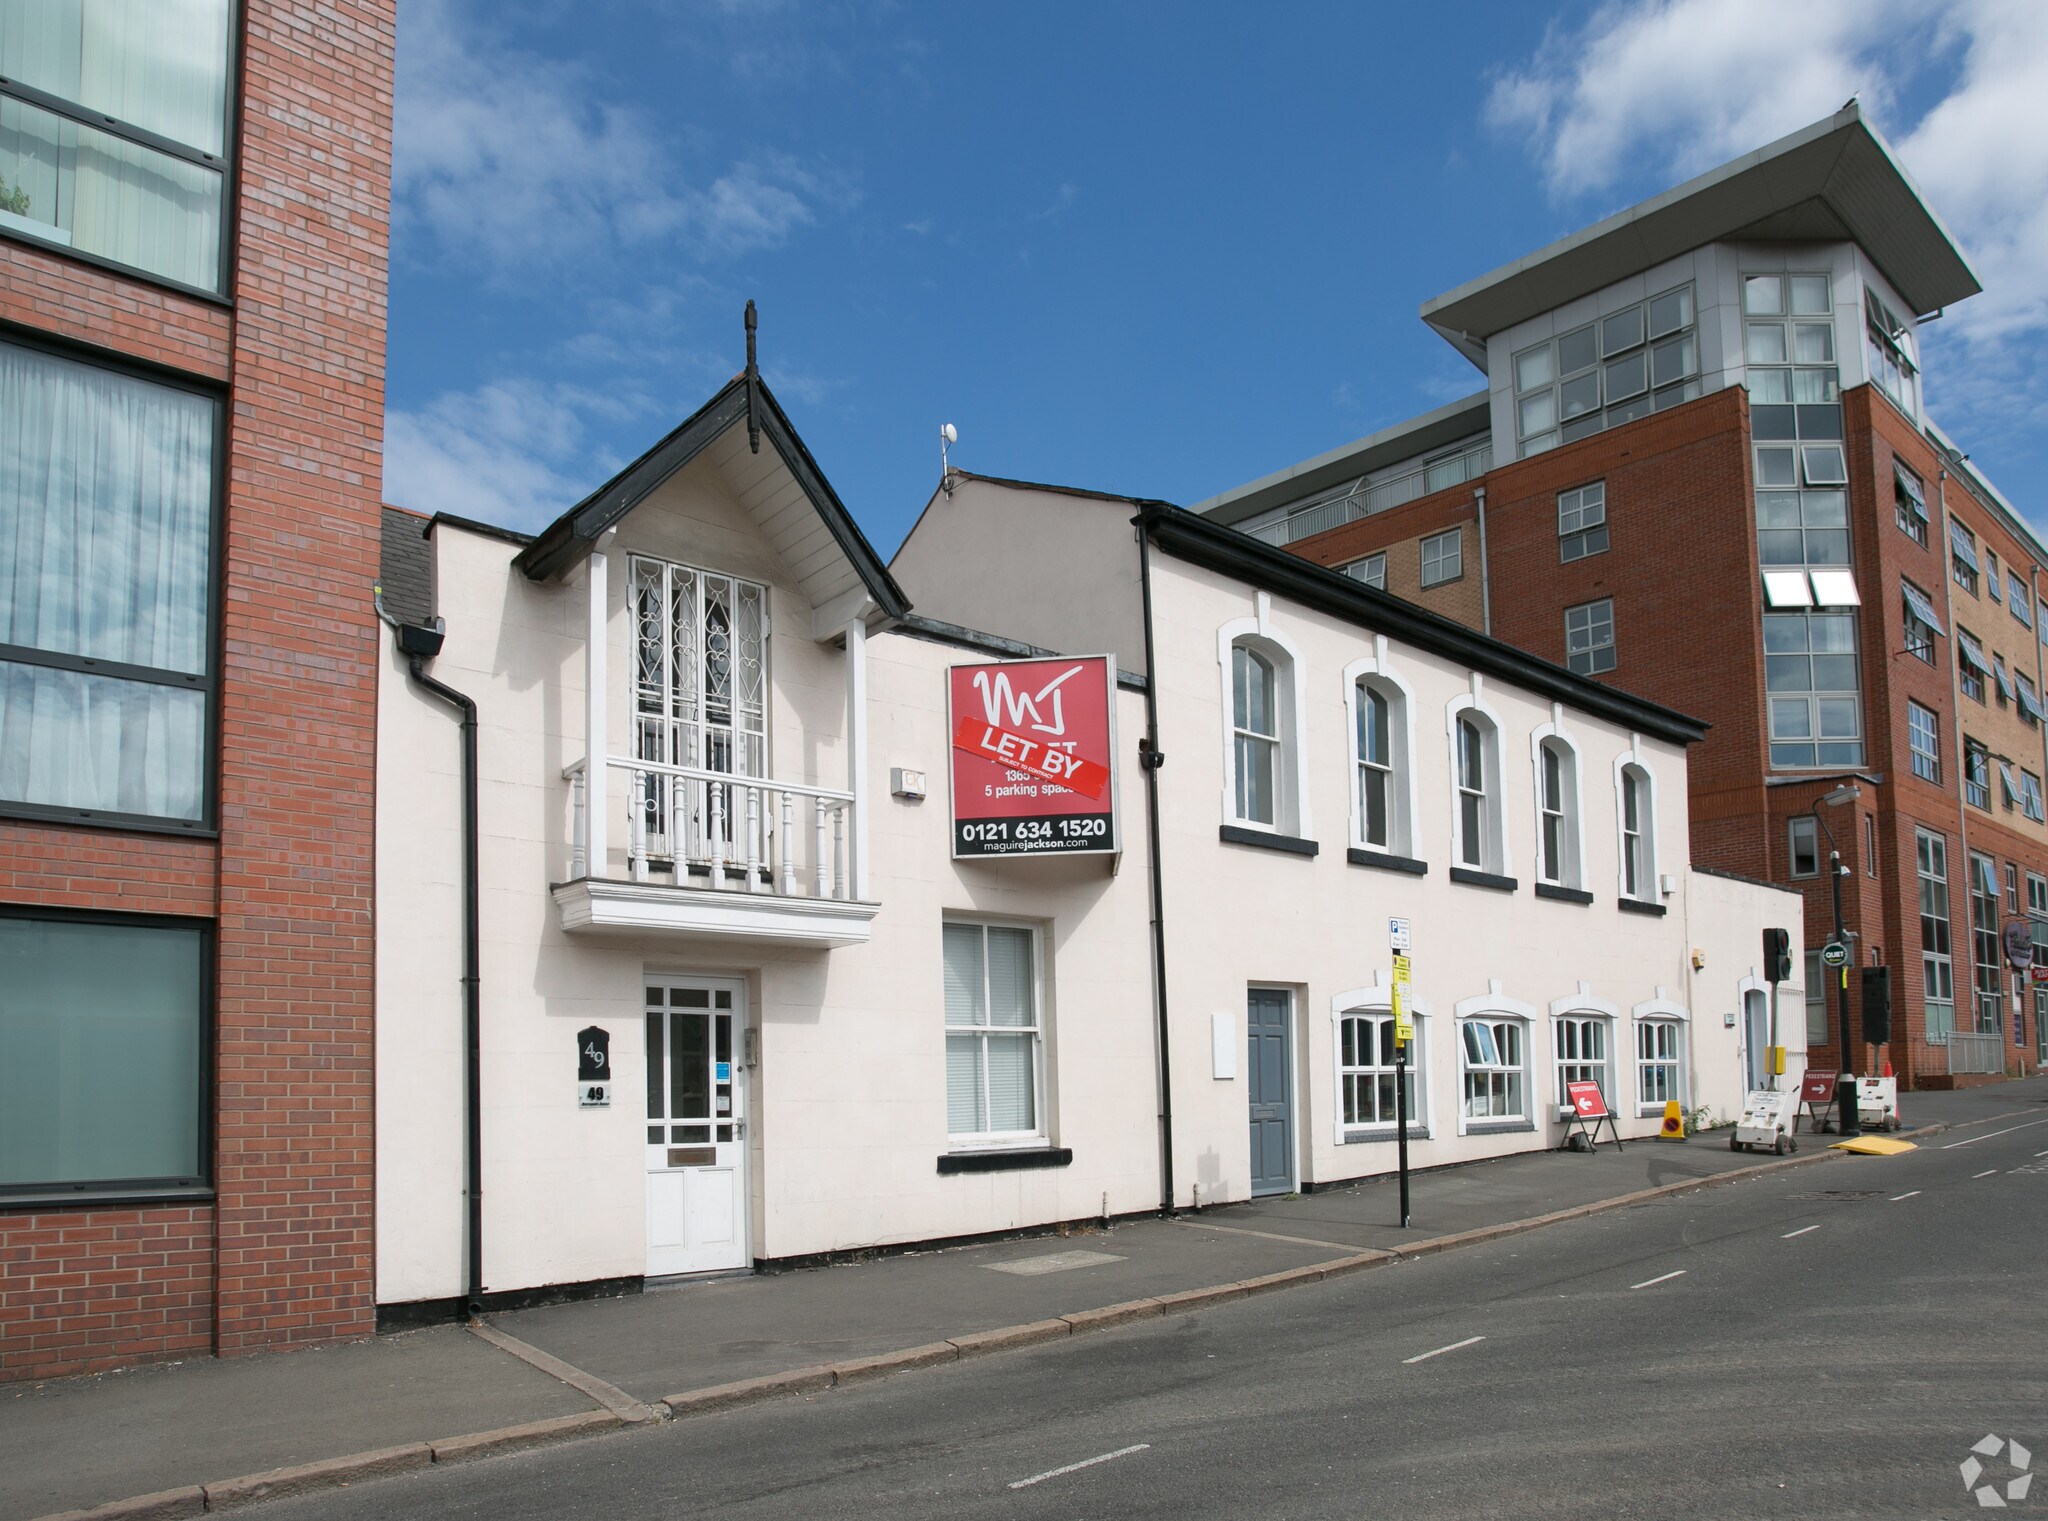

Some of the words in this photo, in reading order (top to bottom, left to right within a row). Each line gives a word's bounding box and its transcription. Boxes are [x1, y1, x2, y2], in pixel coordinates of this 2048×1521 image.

[980, 727, 1038, 762] LET
[1041, 749, 1083, 779] BY
[998, 755, 1020, 767] SUBJECT
[1027, 766, 1054, 779] CONTRACT
[1005, 769, 1031, 782] 1365
[984, 784, 993, 797] 5
[995, 783, 1038, 799] parking
[1041, 784, 1074, 796] spac
[962, 823, 1008, 841] 0121
[1015, 821, 1053, 839] 634
[1058, 818, 1107, 837] 1520
[984, 839, 1088, 852] maguirejackson.com
[587, 1086, 603, 1101] 49
